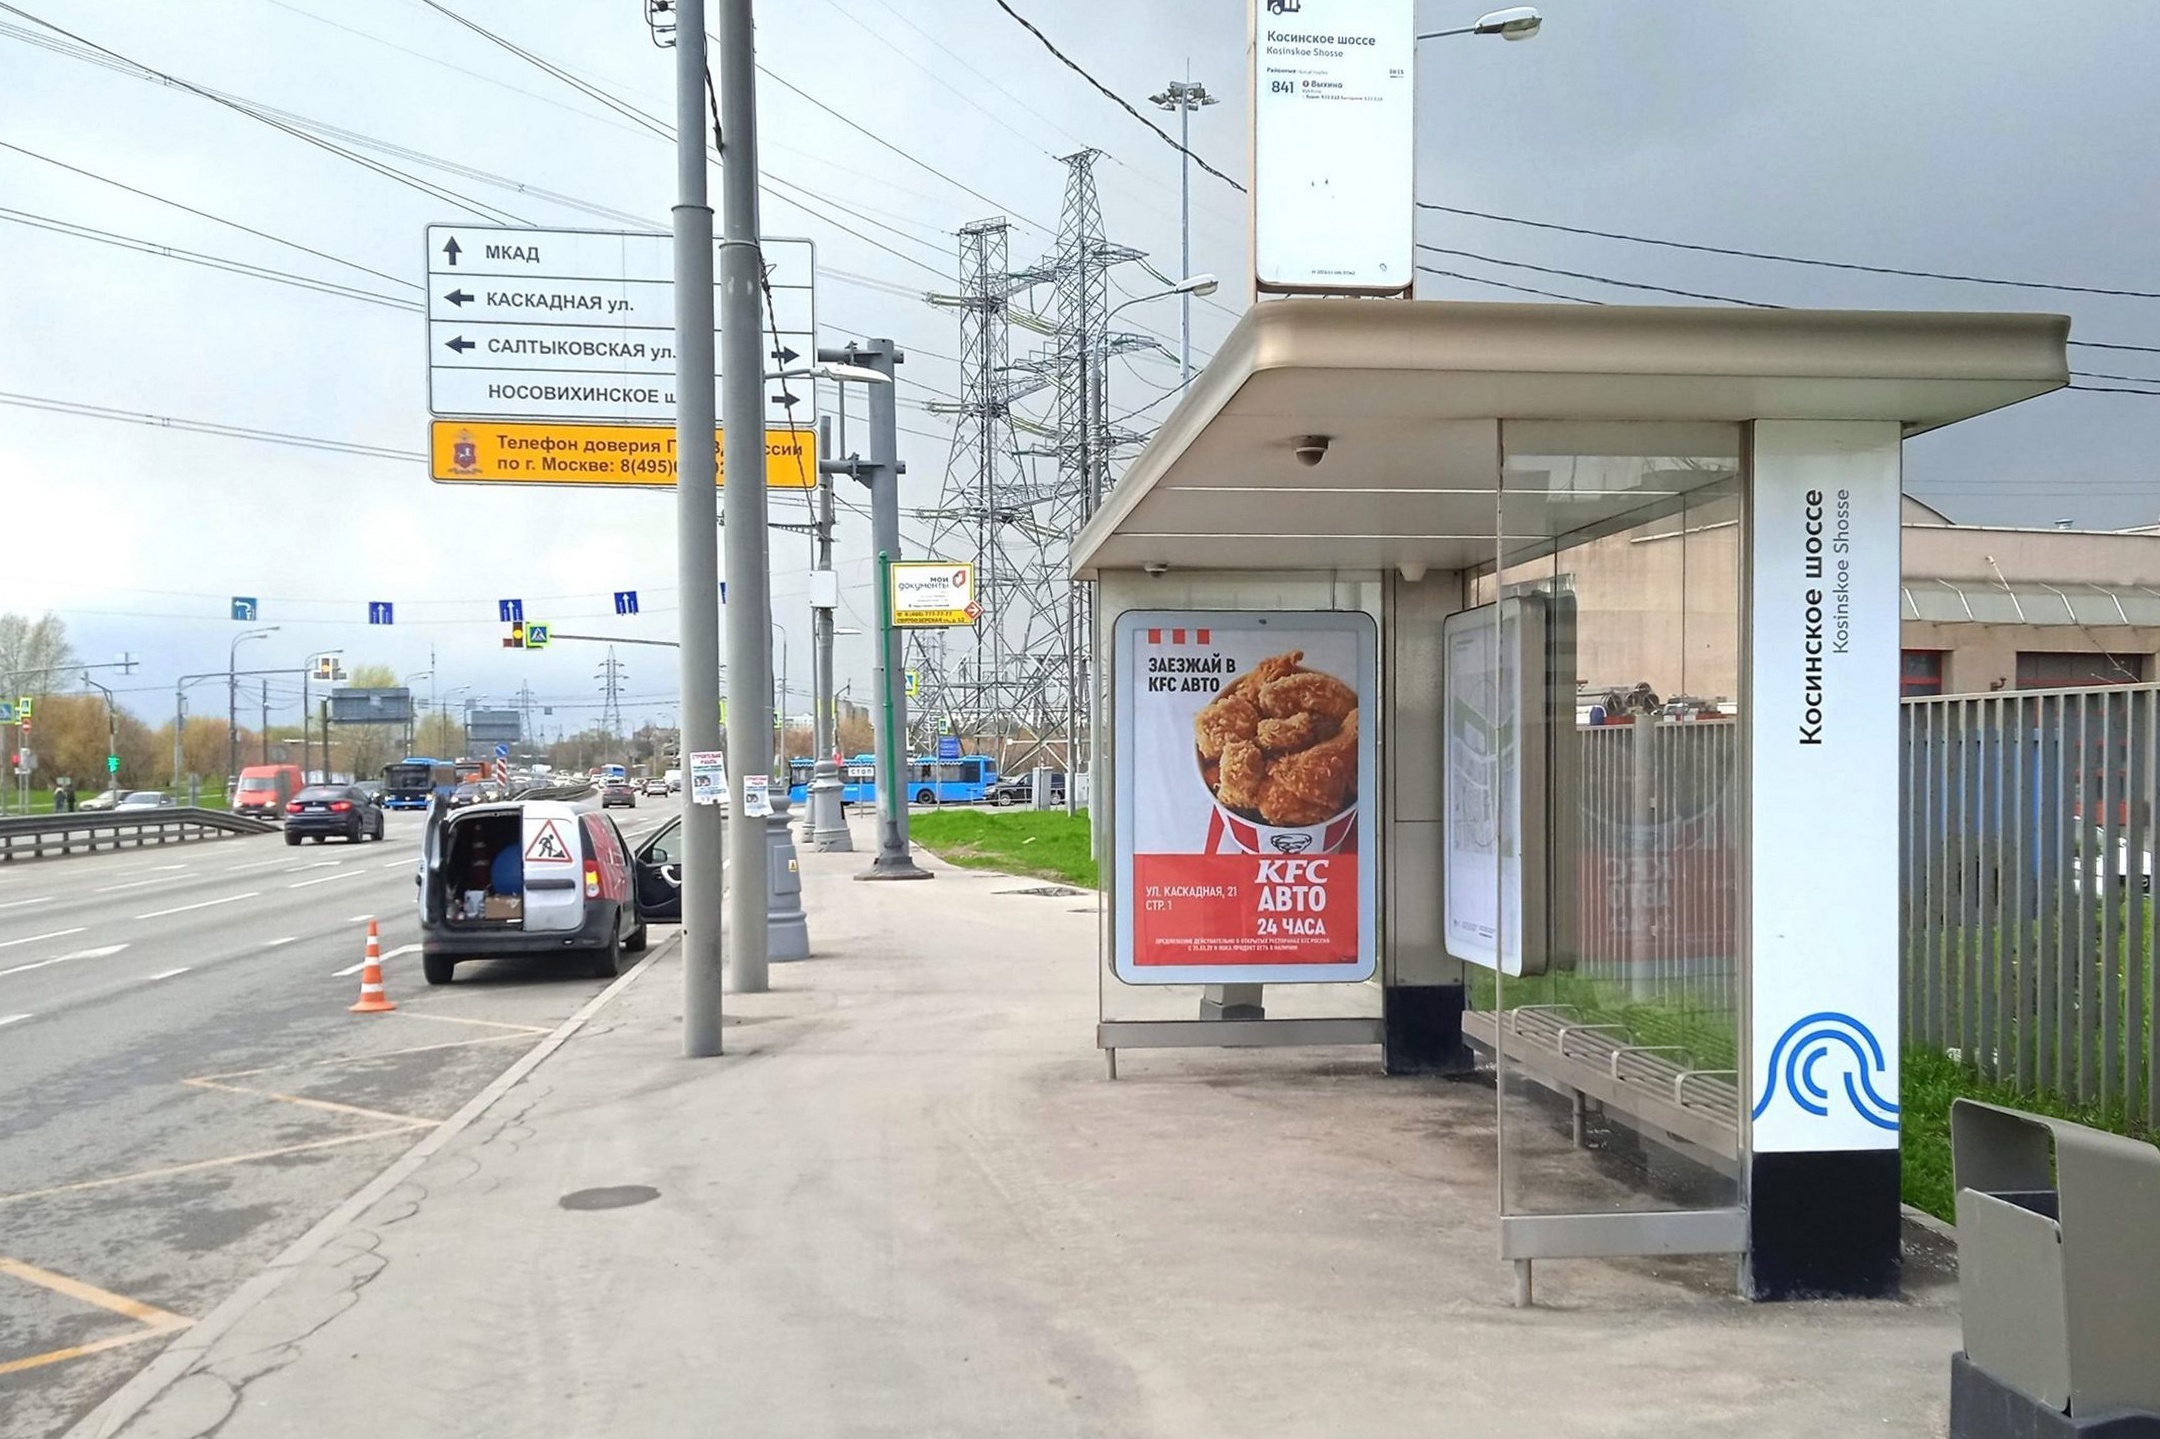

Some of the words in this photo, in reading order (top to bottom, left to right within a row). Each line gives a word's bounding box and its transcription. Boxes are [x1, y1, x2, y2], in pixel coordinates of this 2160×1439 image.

[1267, 30, 1335, 45] Косинское
[1337, 36, 1376, 46] шоссе
[1266, 46, 1312, 57] Kosinskoe
[1313, 47, 1344, 58] Shosse
[1271, 80, 1294, 93] 841
[1311, 80, 1343, 89] Выхино
[485, 244, 540, 264] МКАД
[486, 291, 602, 312] КАСКАДНАЯ
[607, 299, 634, 315] ул.
[487, 338, 645, 358] САЛТЫКОВСКАЯ
[650, 346, 677, 361] ул.
[488, 384, 659, 404] НОСОВИХИНСКОЕ
[497, 435, 578, 456] Телефон
[583, 440, 661, 459] доверия
[497, 459, 520, 472] по
[525, 460, 536, 471] г.
[542, 457, 615, 474] Москве:
[1832, 488, 1850, 554] Shosse
[1805, 489, 1823, 579] шоссе
[898, 582, 950, 592] документы
[1831, 559, 1850, 654] Kosinskoe
[1148, 652, 1222, 674] ЗАЕЗЖАЙ
[1226, 658, 1236, 674] В
[1799, 588, 1823, 745] Косинское
[1148, 676, 1177, 693] KFC
[1180, 677, 1220, 693] АВТО
[1254, 859, 1329, 884] KFC
[1145, 885, 1160, 897] УЛ.
[1164, 885, 1225, 899] КАСКАДНАЯ,
[1227, 885, 1238, 897] 21
[1257, 885, 1326, 912] АВТО
[1145, 899, 1166, 911] СТР.
[1167, 899, 1173, 911] 1
[1257, 917, 1278, 935] 24
[1281, 917, 1326, 935] ЧАСА
